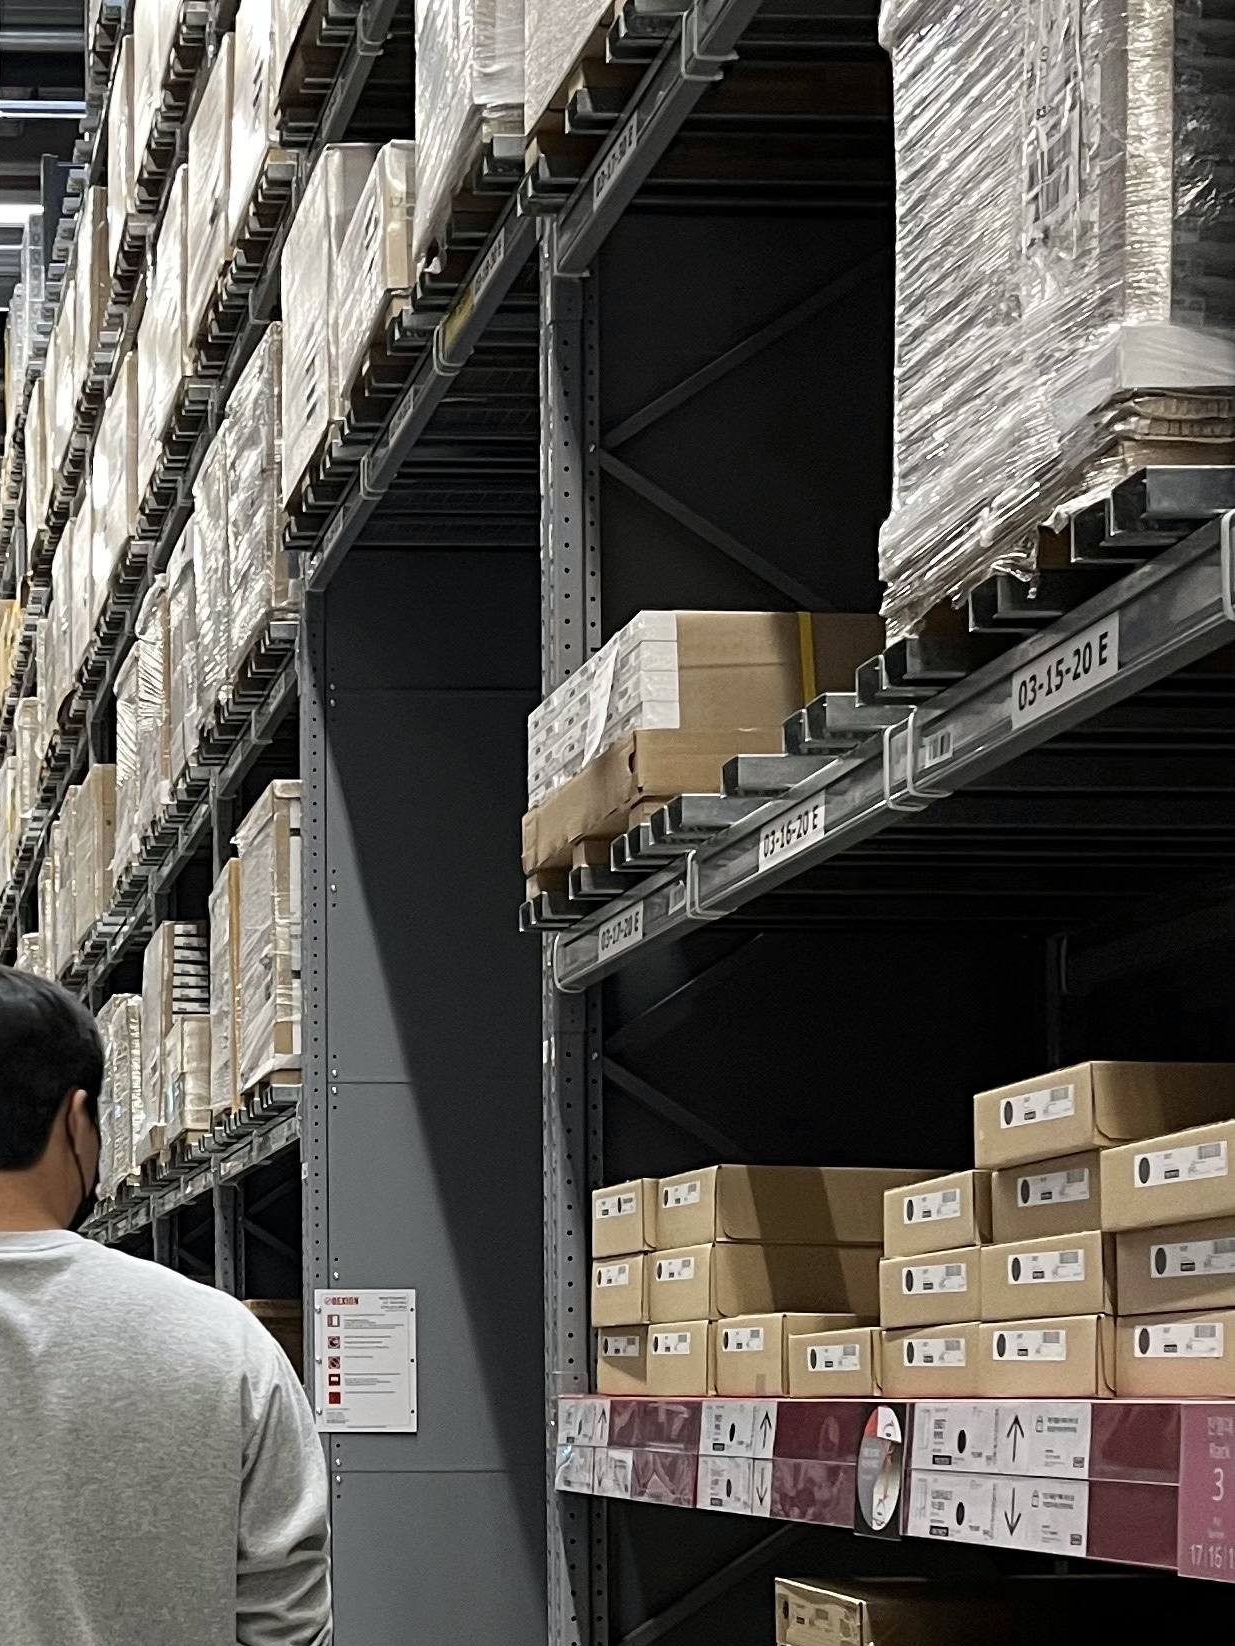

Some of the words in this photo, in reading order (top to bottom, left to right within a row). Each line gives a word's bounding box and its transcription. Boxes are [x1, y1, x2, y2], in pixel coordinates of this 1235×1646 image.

[1018, 641, 1092, 711] 03-15-20
[1098, 631, 1108, 666] E
[764, 810, 809, 858] 03-16-20
[812, 804, 819, 830] E
[1212, 1468, 1224, 1501] 3
[1189, 1544, 1203, 1566] 17
[1208, 1545, 1223, 1569] 16
